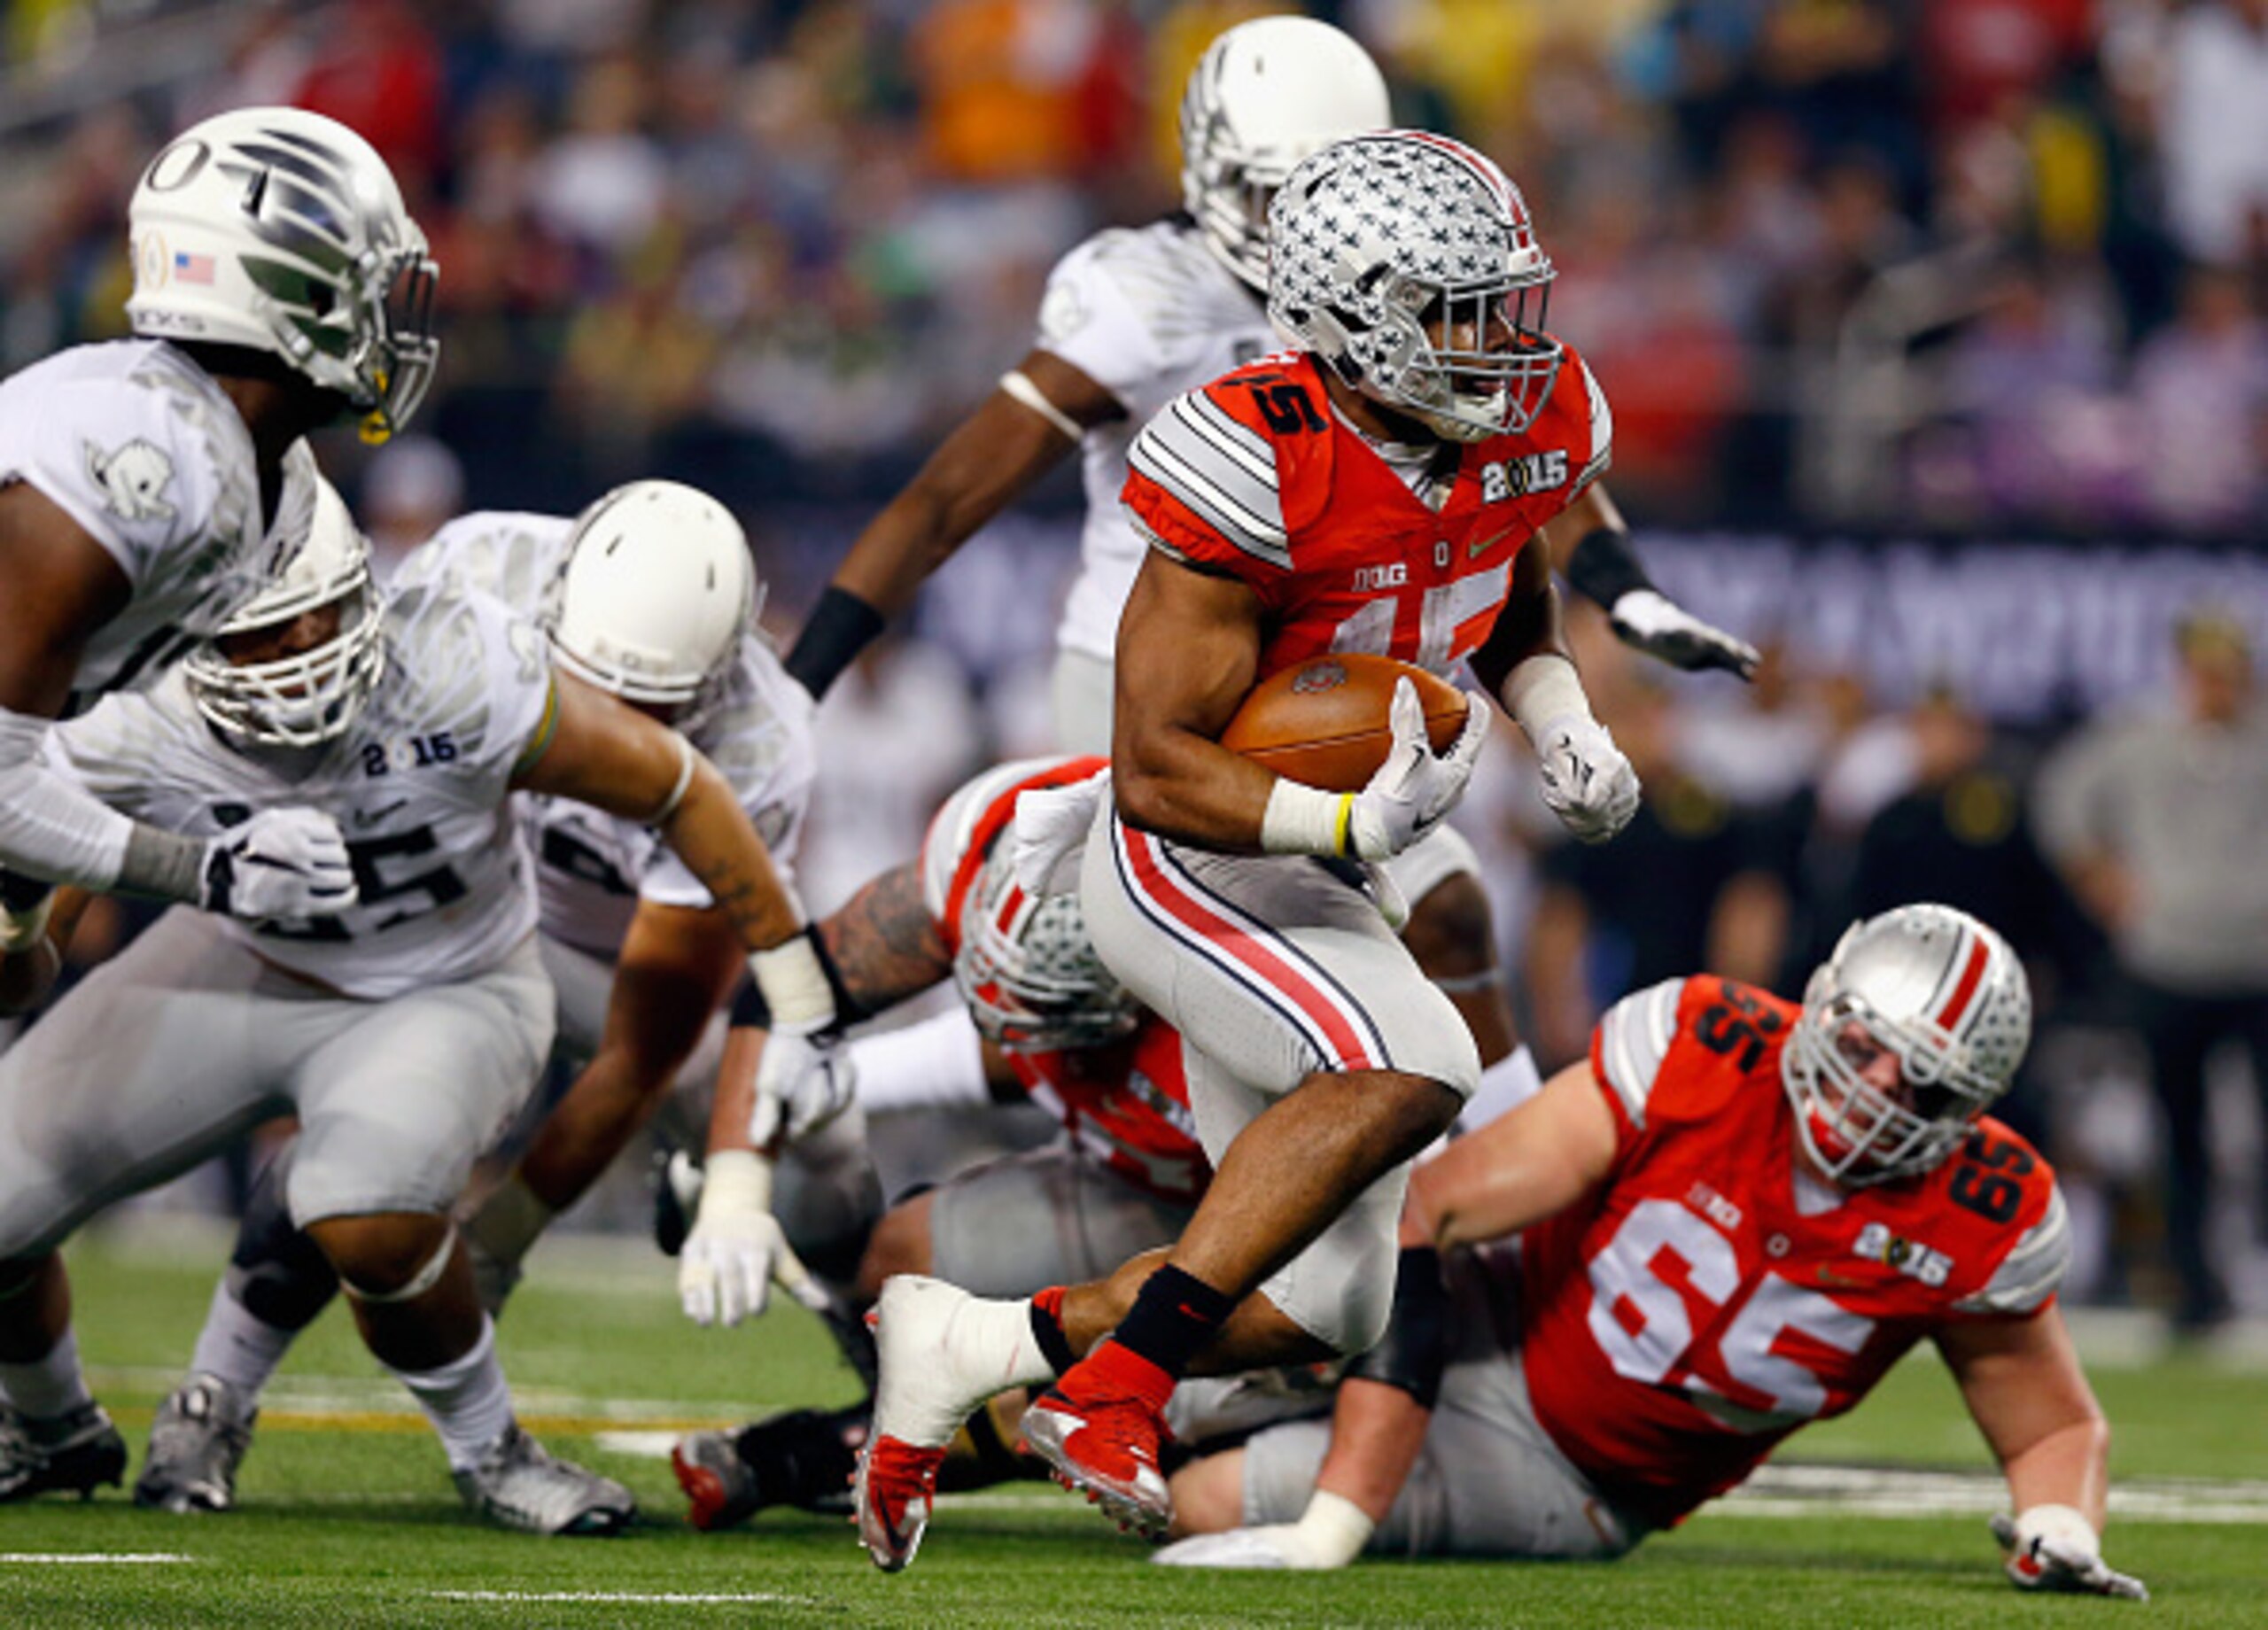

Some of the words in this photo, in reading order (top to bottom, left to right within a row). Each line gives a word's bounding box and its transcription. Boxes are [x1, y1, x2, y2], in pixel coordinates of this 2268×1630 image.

[1480, 449, 1569, 504] 2015
[1951, 1132, 2035, 1224] 65
[1588, 1199, 1876, 1434] 65
